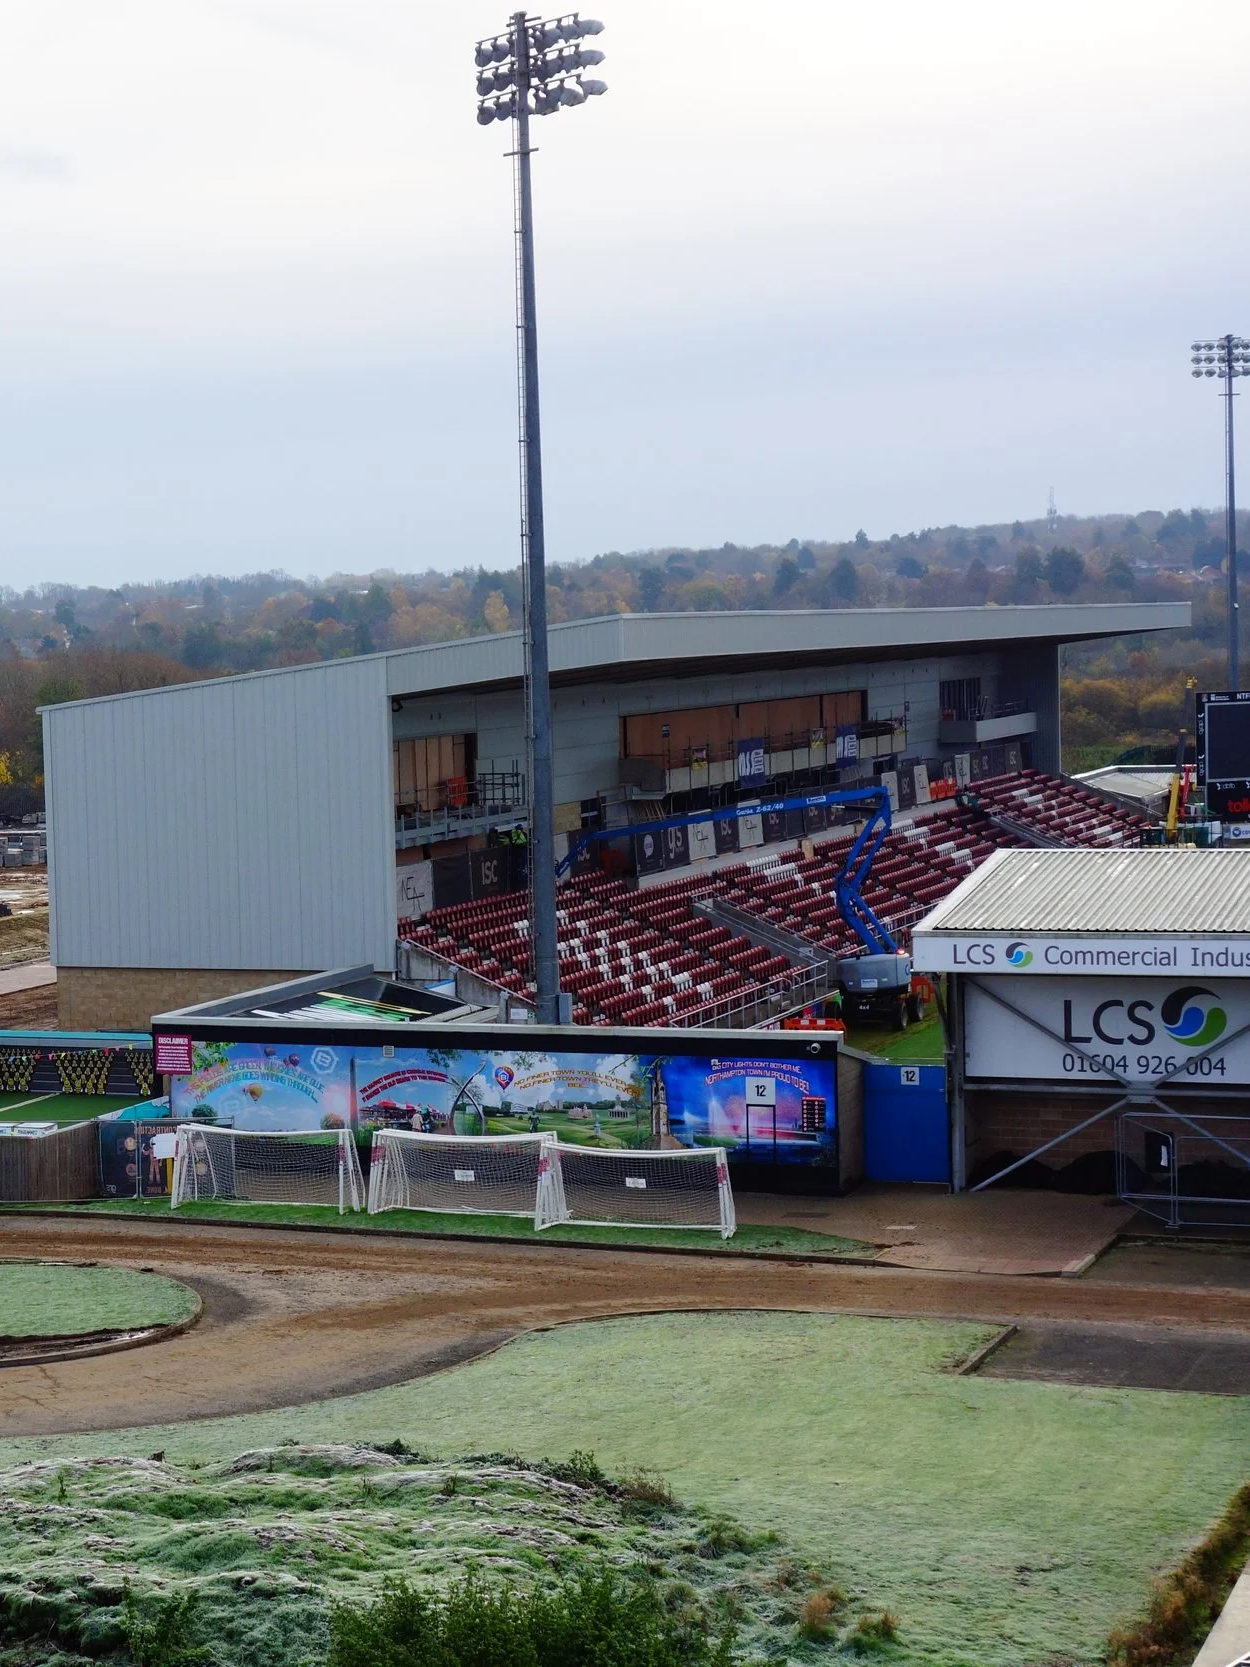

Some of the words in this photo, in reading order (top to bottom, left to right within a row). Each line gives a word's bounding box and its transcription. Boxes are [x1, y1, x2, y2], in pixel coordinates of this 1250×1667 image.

[953, 944, 995, 965] LCS
[1044, 945, 1177, 967] Commercial
[1064, 999, 1155, 1046] LCS
[770, 1062, 791, 1071] BOTHER
[1062, 1053, 1129, 1075] 01604
[1137, 1055, 1178, 1075] 926
[1186, 1056, 1227, 1076] 004
[705, 1069, 746, 1087] NORTHAMPTON
[770, 1070, 790, 1084] PROUD
[904, 1070, 916, 1082] 12
[754, 1085, 766, 1097] 12
